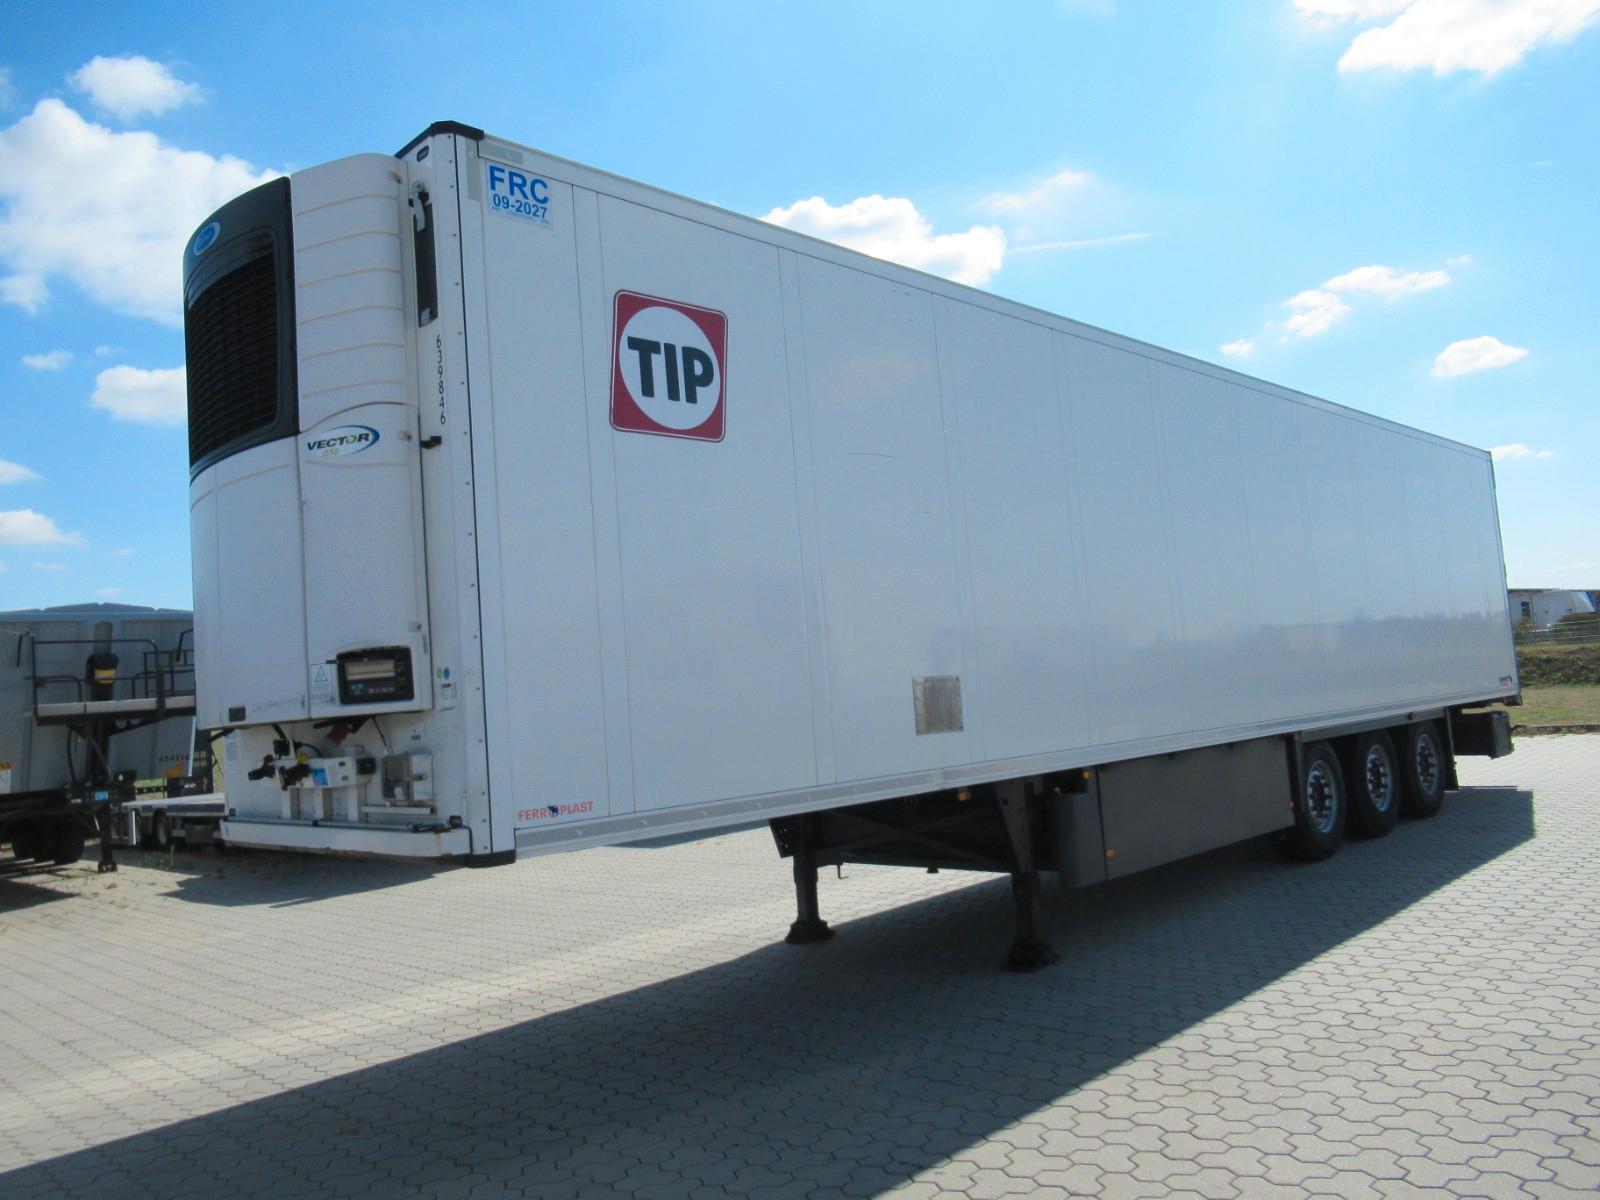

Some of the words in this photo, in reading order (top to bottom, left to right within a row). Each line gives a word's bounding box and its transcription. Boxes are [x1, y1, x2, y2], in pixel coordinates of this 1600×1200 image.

[489, 164, 549, 204] FRC
[493, 193, 548, 219] 09-2027
[627, 335, 715, 405] TIP
[307, 433, 370, 451] VECTOR
